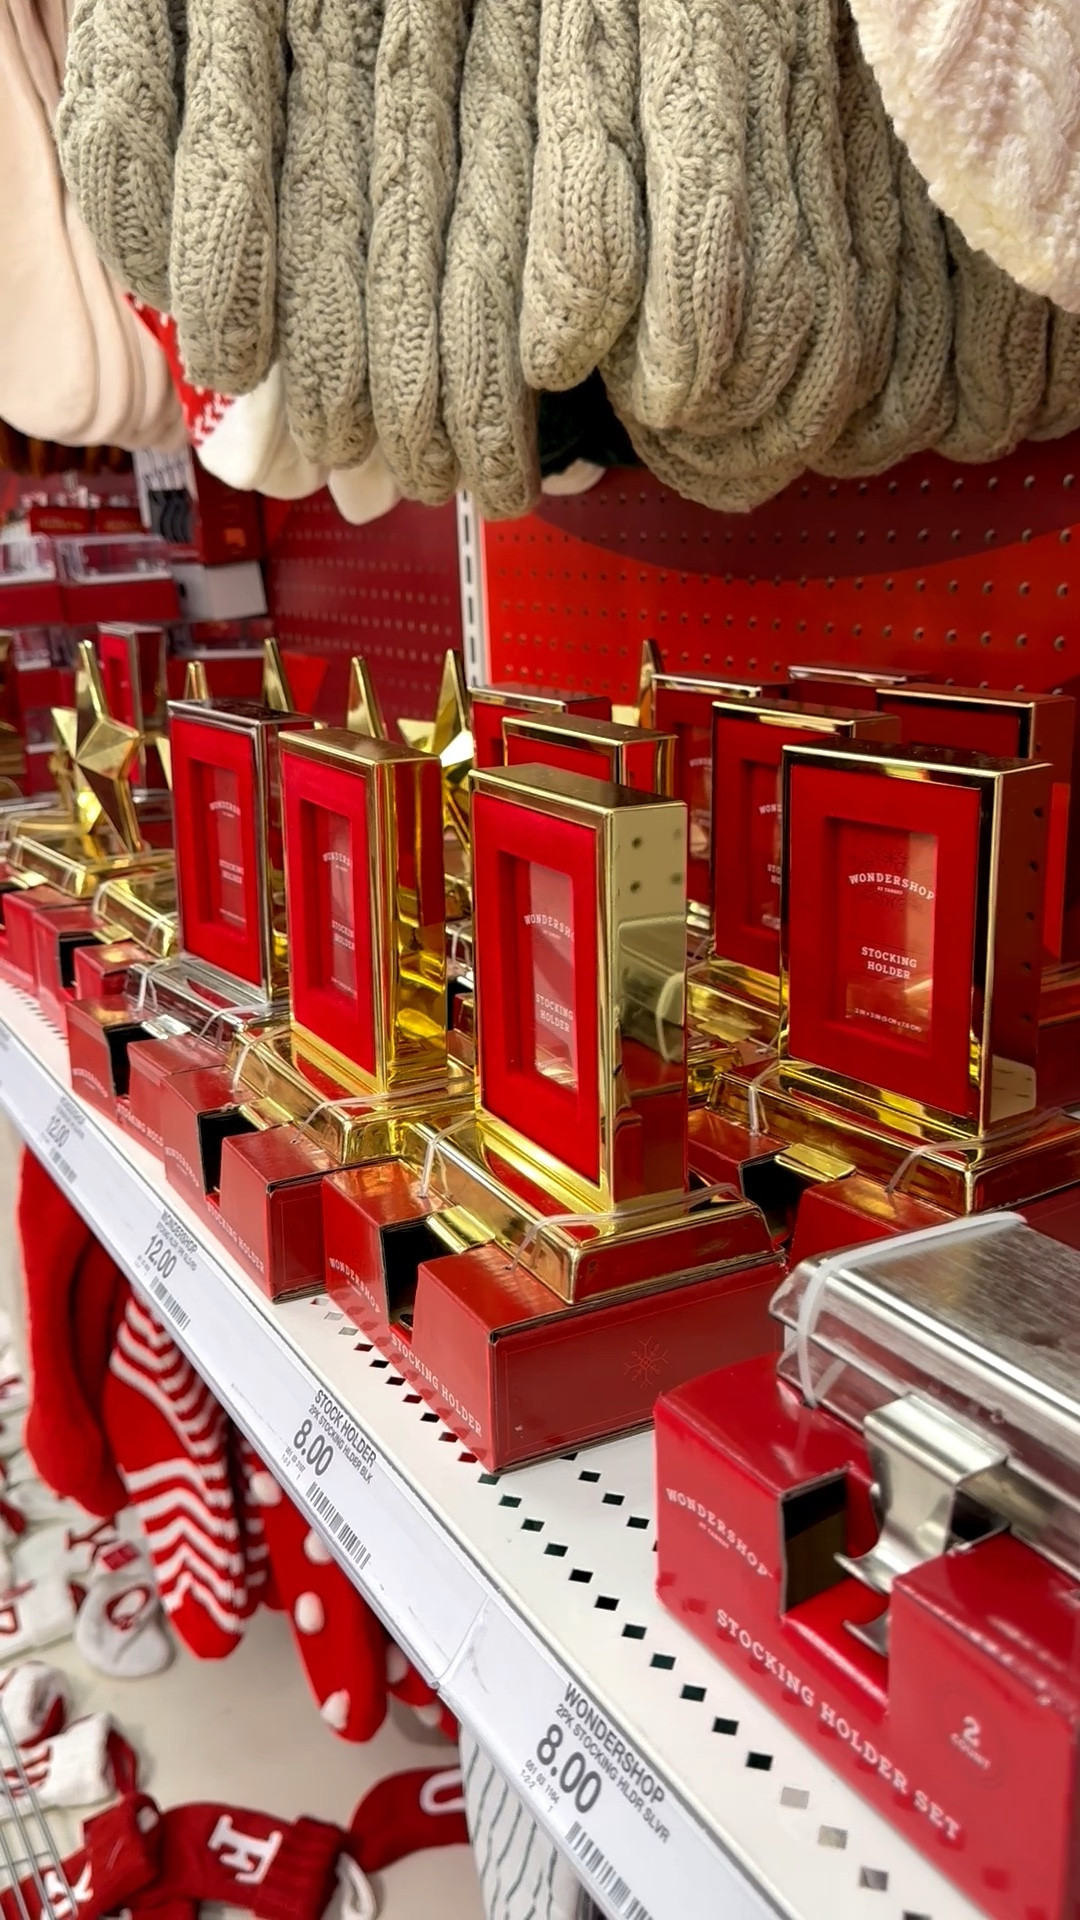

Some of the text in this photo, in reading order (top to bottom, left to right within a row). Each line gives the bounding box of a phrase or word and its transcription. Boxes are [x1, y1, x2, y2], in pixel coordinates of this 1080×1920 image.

[848, 872, 935, 900] WONDERSHOP
[861, 946, 918, 969] STOCKING
[867, 961, 911, 980] HOLDER
[535, 993, 574, 1020] STOCKING
[540, 1009, 570, 1033] HOLDER
[144, 1233, 177, 1279] 12.00
[329, 1257, 381, 1314] WONDERSHOP
[390, 1333, 483, 1437] STOCKING HOLDER
[293, 1418, 334, 1476] 8.00
[315, 1389, 377, 1467] STOCK HOLDER
[319, 1415, 345, 1450] STOCKING
[360, 1466, 373, 1484] BLK
[666, 1487, 768, 1576] WONDERSHOP
[564, 1681, 666, 1805] WONDERSHOP
[716, 1608, 961, 1840] STOCKING HOLDER SET
[963, 1716, 981, 1747] 2
[536, 1723, 602, 1814] 8.00
[555, 1703, 671, 1844] 2PK STOCKING HLDR SLVR
